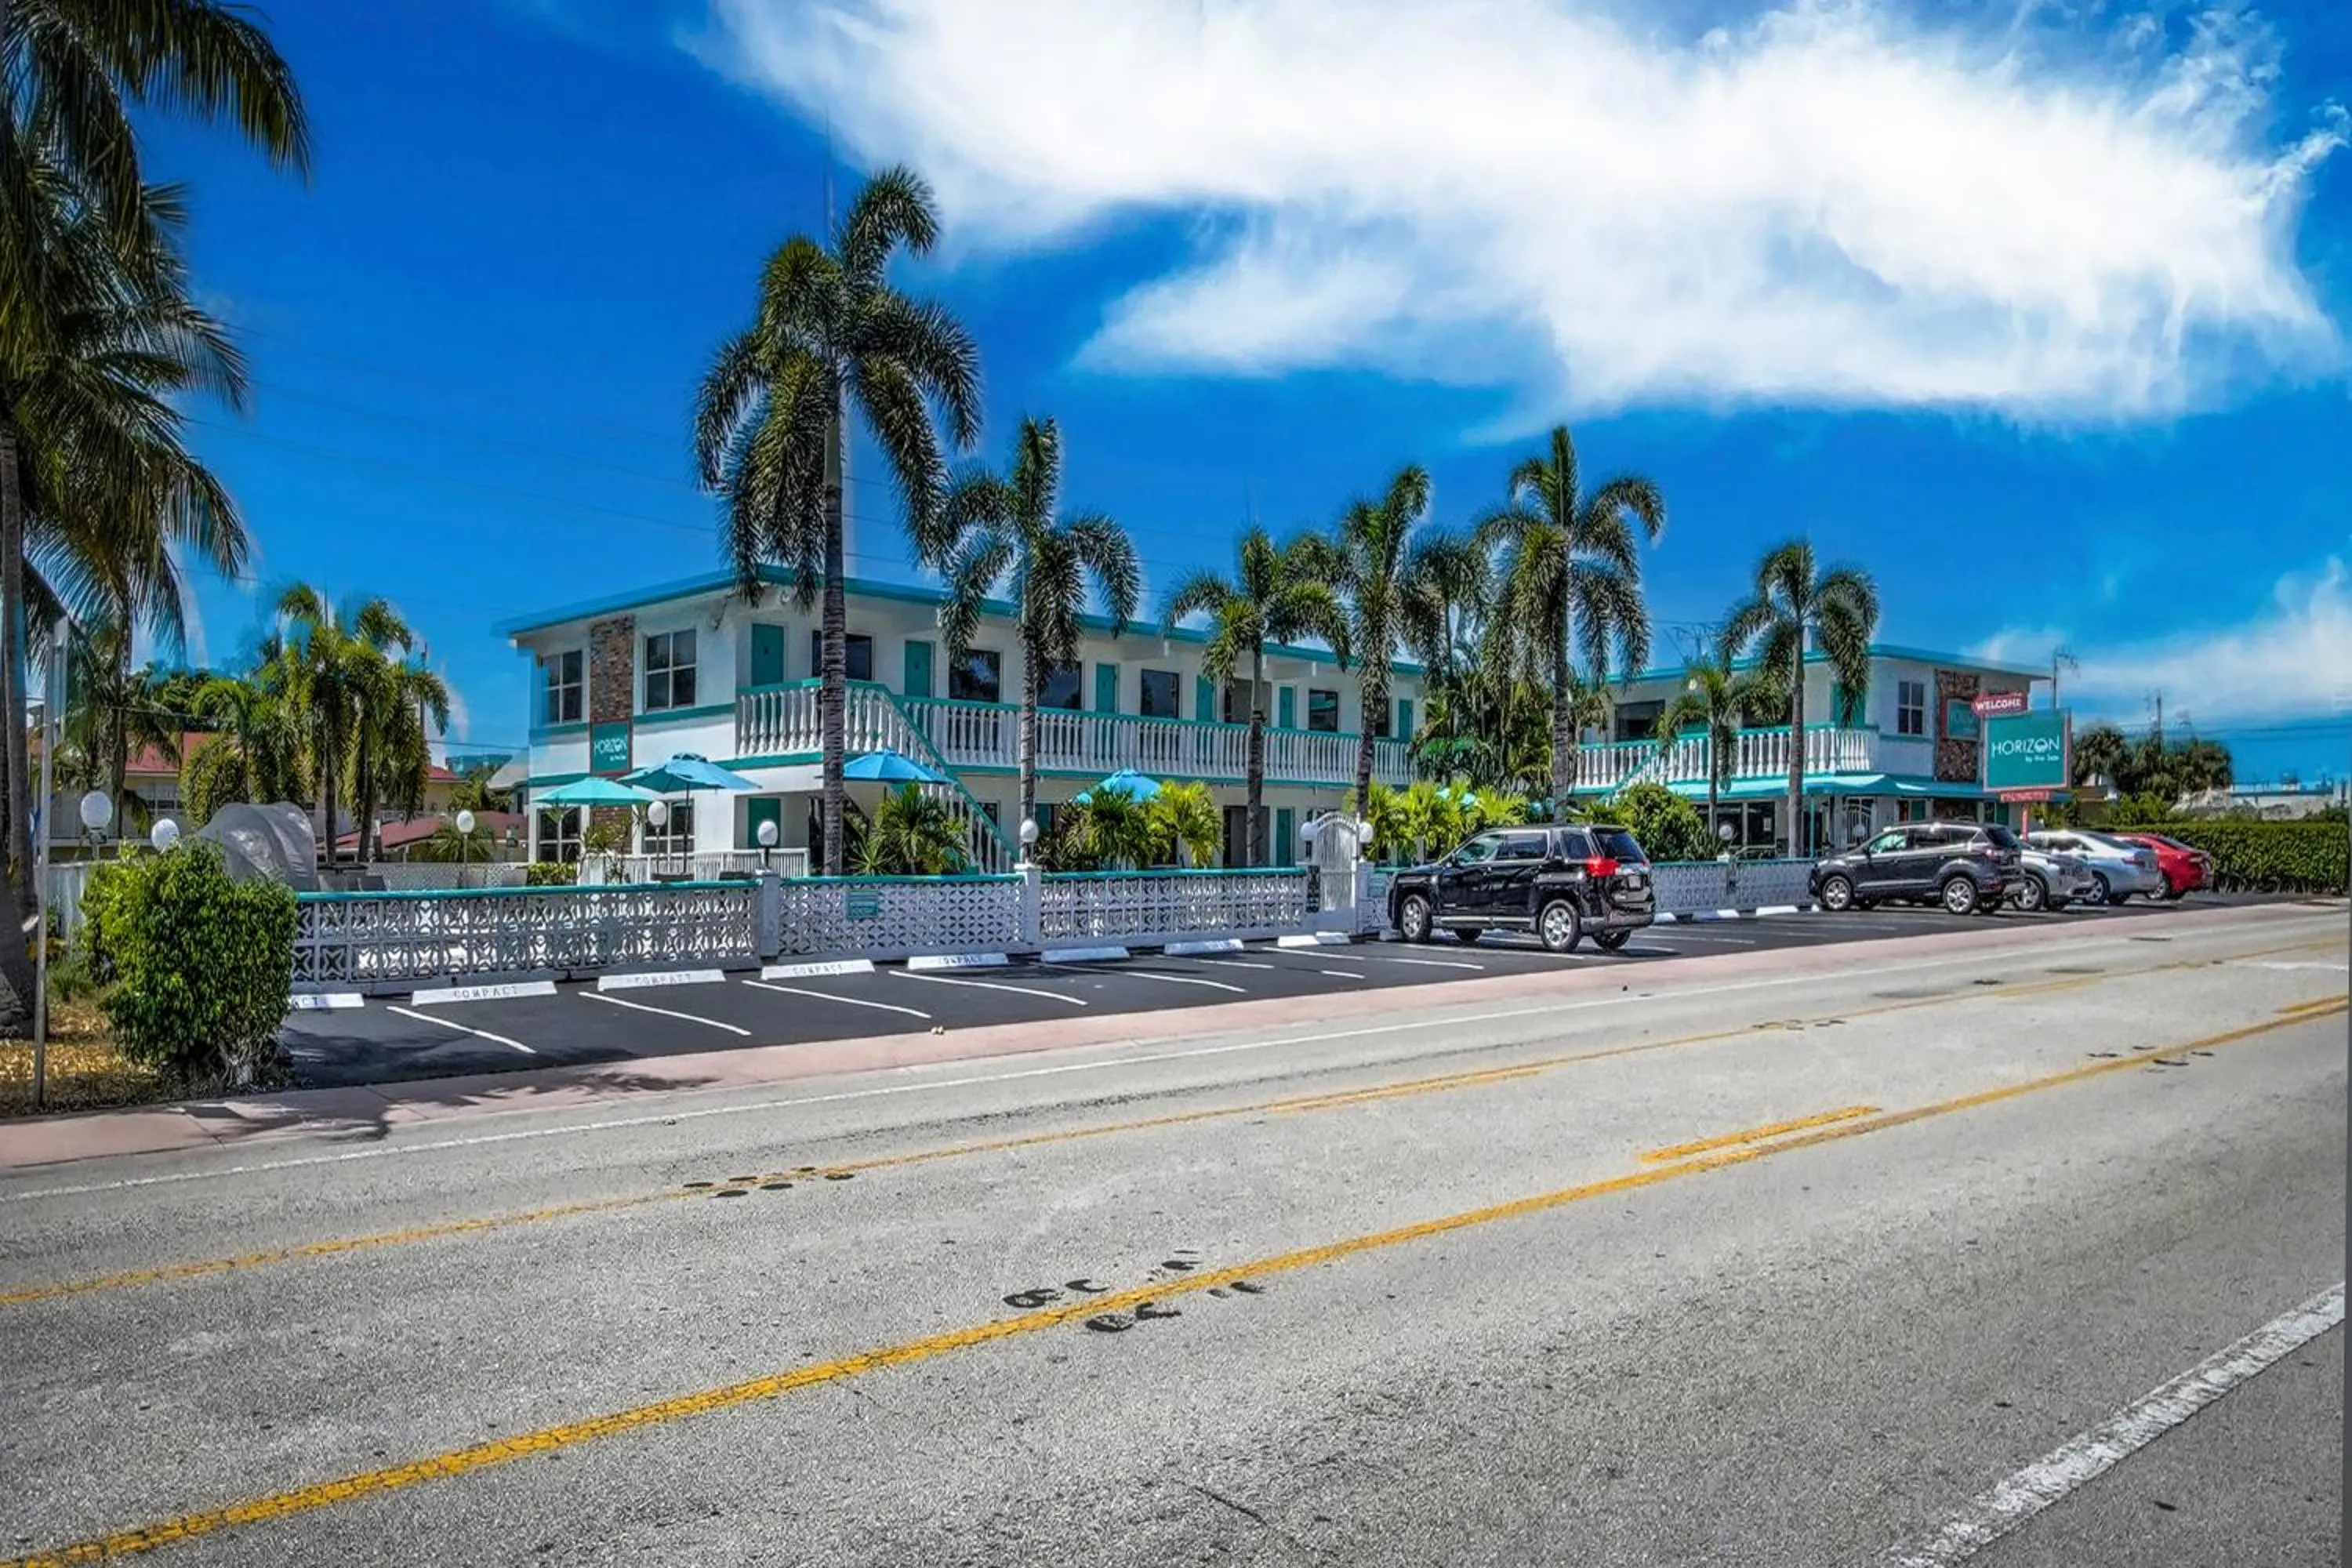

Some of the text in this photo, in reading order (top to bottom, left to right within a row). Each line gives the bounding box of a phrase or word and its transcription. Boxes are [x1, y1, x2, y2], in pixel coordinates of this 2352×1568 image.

[1975, 699, 2022, 711] WELCOME
[1991, 735, 2060, 759] HORIZON
[453, 985, 517, 998] COMPACT
